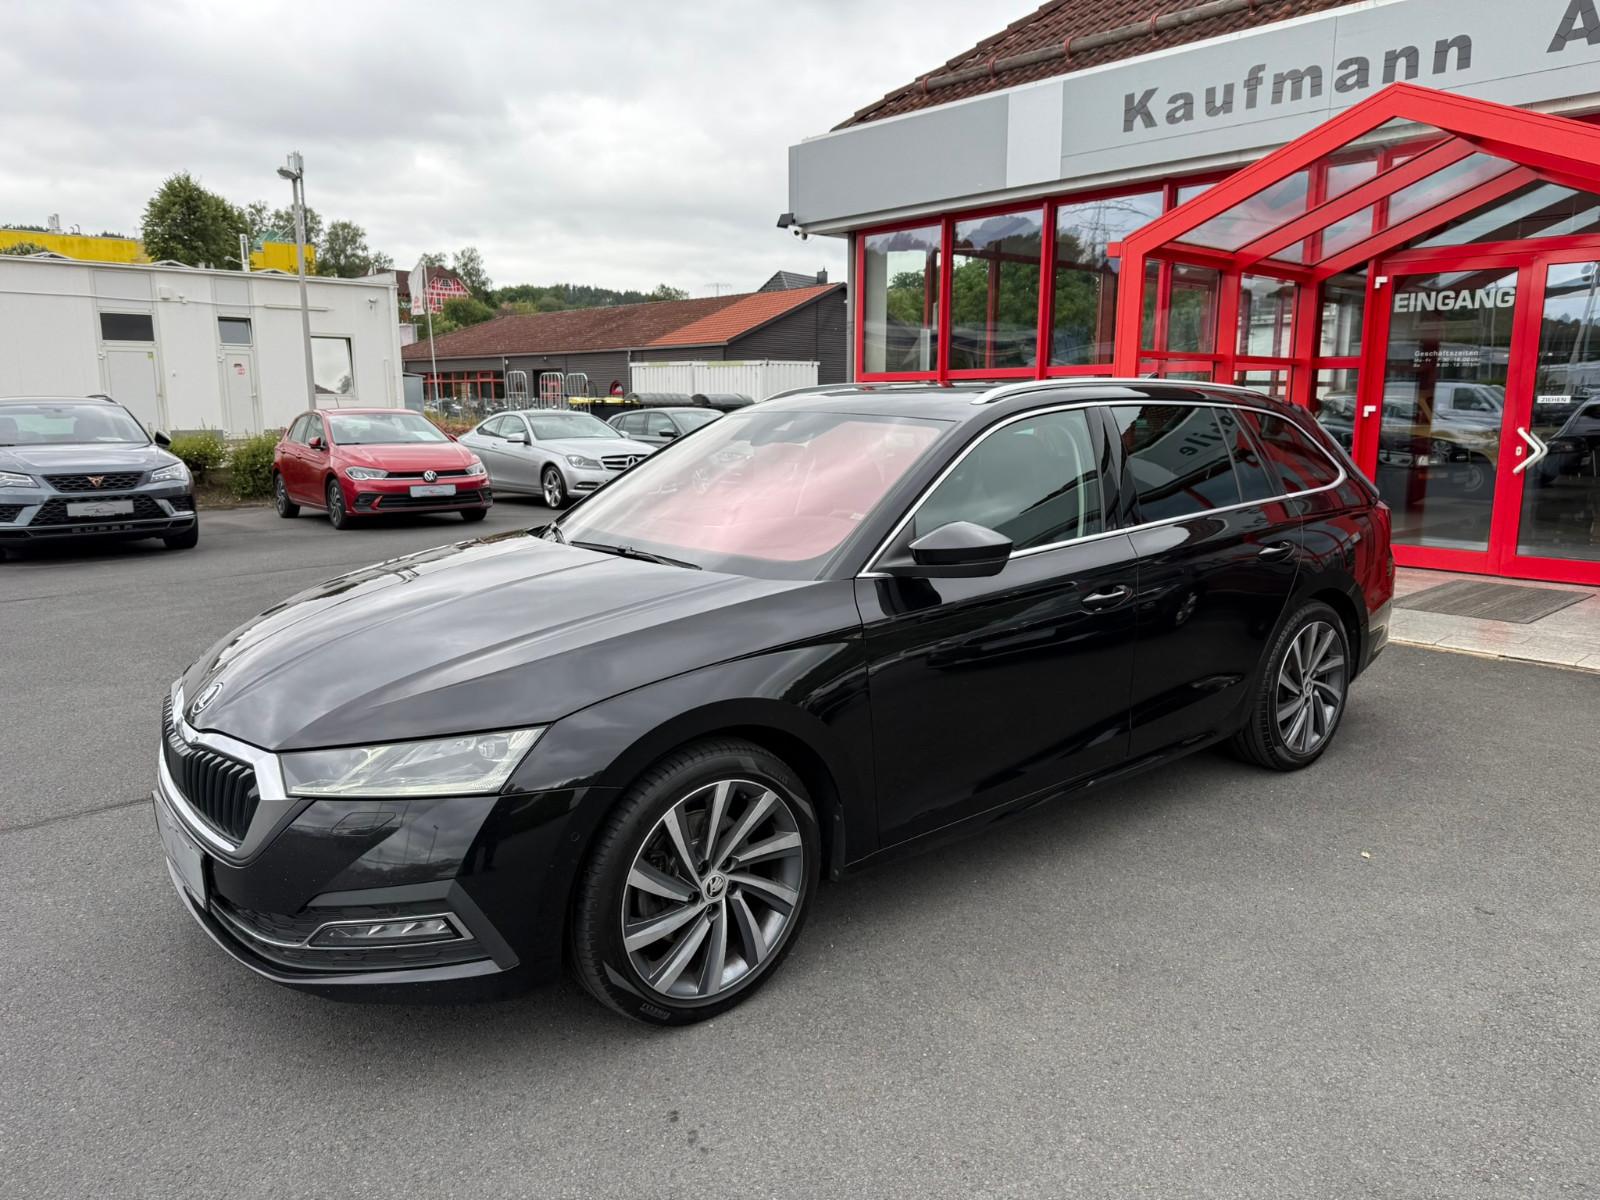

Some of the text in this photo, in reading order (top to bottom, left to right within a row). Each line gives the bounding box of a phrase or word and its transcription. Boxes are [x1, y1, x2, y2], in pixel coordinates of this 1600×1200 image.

[1122, 0, 1600, 133] Kaufmann A
[1393, 287, 1516, 313] EINGANG
